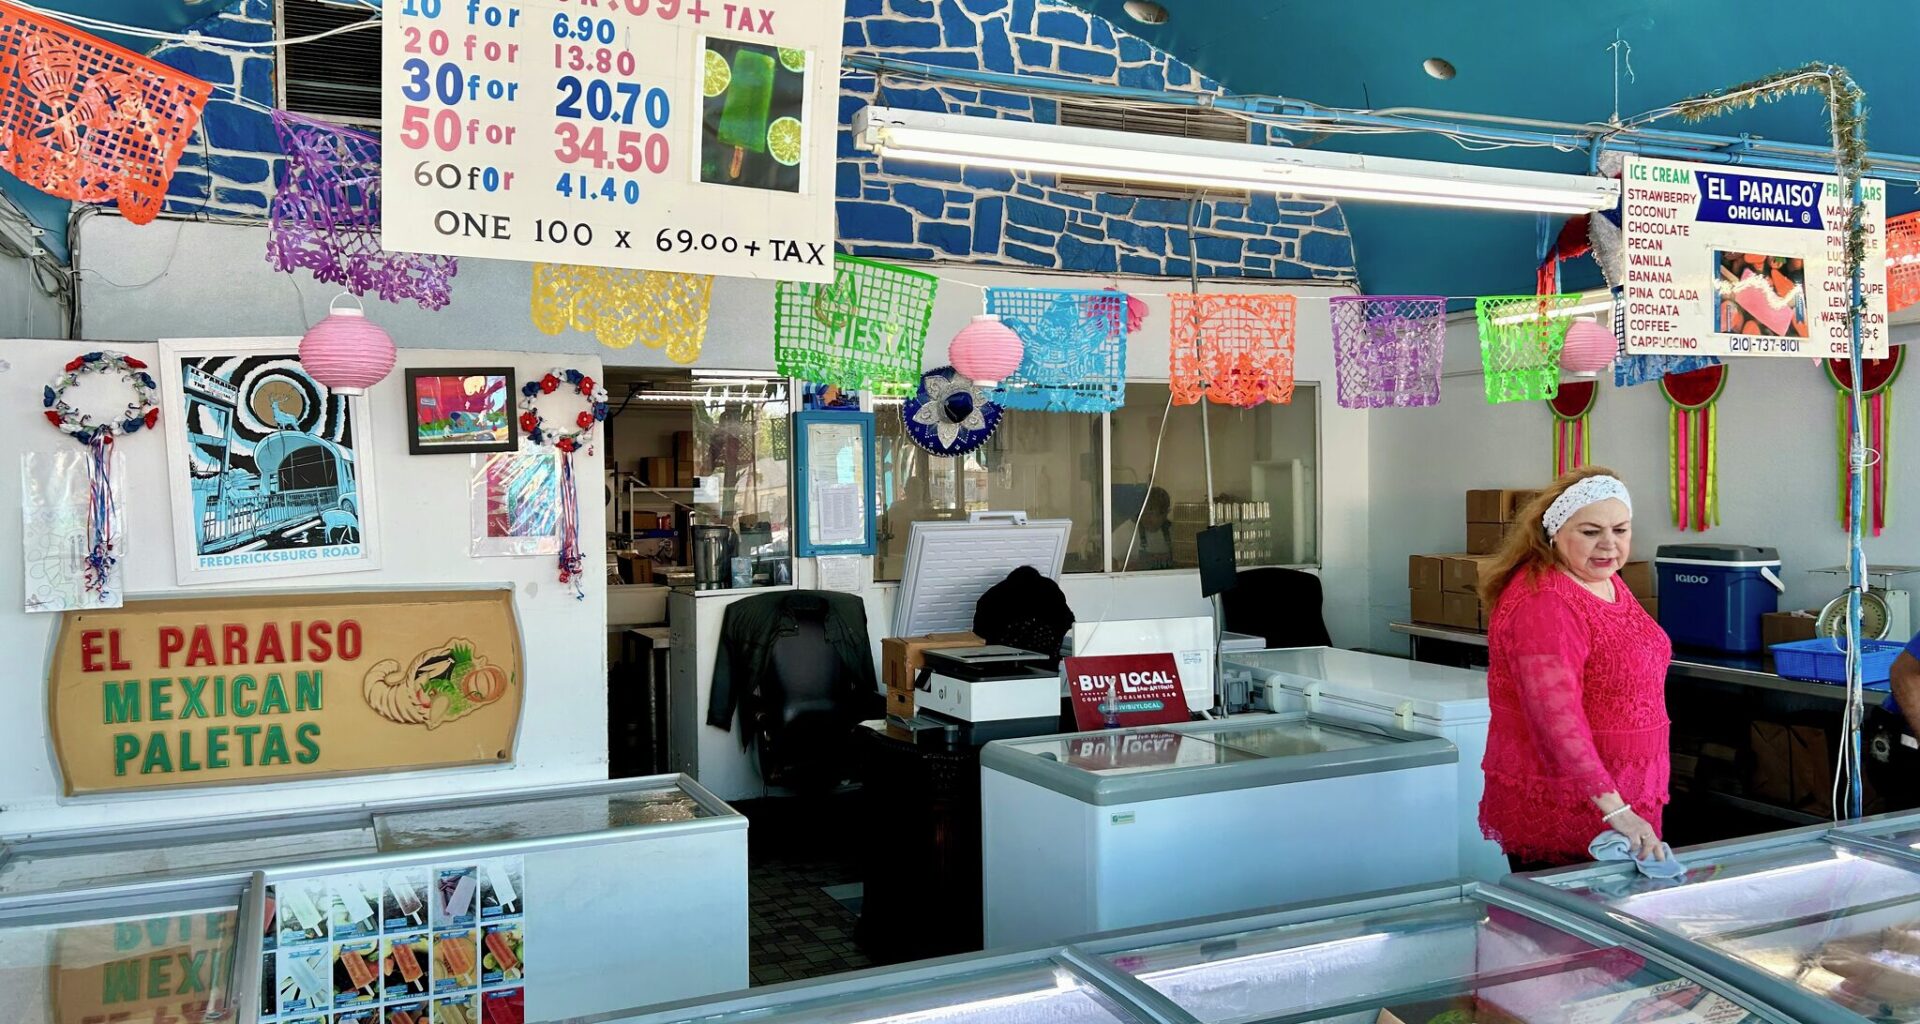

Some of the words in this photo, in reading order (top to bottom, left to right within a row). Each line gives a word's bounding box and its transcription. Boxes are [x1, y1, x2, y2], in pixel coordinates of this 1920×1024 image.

[402, 0, 442, 19] 10
[466, 0, 520, 28] for
[552, 12, 616, 45] 6.90
[723, 3, 776, 36] TAX
[404, 26, 450, 57] 20
[463, 34, 519, 63] for
[553, 43, 637, 77] 13.80
[401, 57, 464, 105] 30
[554, 75, 671, 130] 20.70
[400, 104, 462, 152] 50
[553, 121, 670, 175] 34.50
[1629, 163, 1648, 181] ICE
[1652, 166, 1690, 184] CREAM
[555, 171, 640, 206] 41.40
[1627, 187, 1697, 205] STRAWBERRY
[1858, 185, 1882, 201] ARS
[1627, 204, 1678, 219] COCONUT
[1727, 204, 1794, 224] ORIGINAL
[433, 209, 512, 241] ONE
[534, 218, 593, 248] 100
[1627, 220, 1690, 237] CHOCOLATE
[1628, 237, 1663, 251] PECAN
[1826, 235, 1878, 250] PINPLE
[1628, 253, 1673, 268] VANILLA
[1628, 270, 1673, 284] BANANA
[1827, 266, 1866, 279] PICKS
[1629, 286, 1654, 299] PINA
[1658, 288, 1700, 301] COLADA
[1823, 281, 1884, 294] CANTAOUPE
[1629, 302, 1680, 317] ORCHATA
[828, 312, 913, 361] FIESTA
[1630, 335, 1698, 349] CAPPUCCINO
[199, 550, 318, 568] FREDERICKSBURG
[322, 545, 361, 558] ROAD
[1675, 573, 1709, 585] IGLOO
[81, 627, 132, 673] EL
[158, 618, 363, 668] PARAISO
[1078, 674, 1117, 692] BUY
[1119, 670, 1173, 693] LOCAL
[102, 669, 324, 725] MEXICAN
[1115, 692, 1160, 701] OCALMENTE
[113, 722, 322, 777] PALETAS
